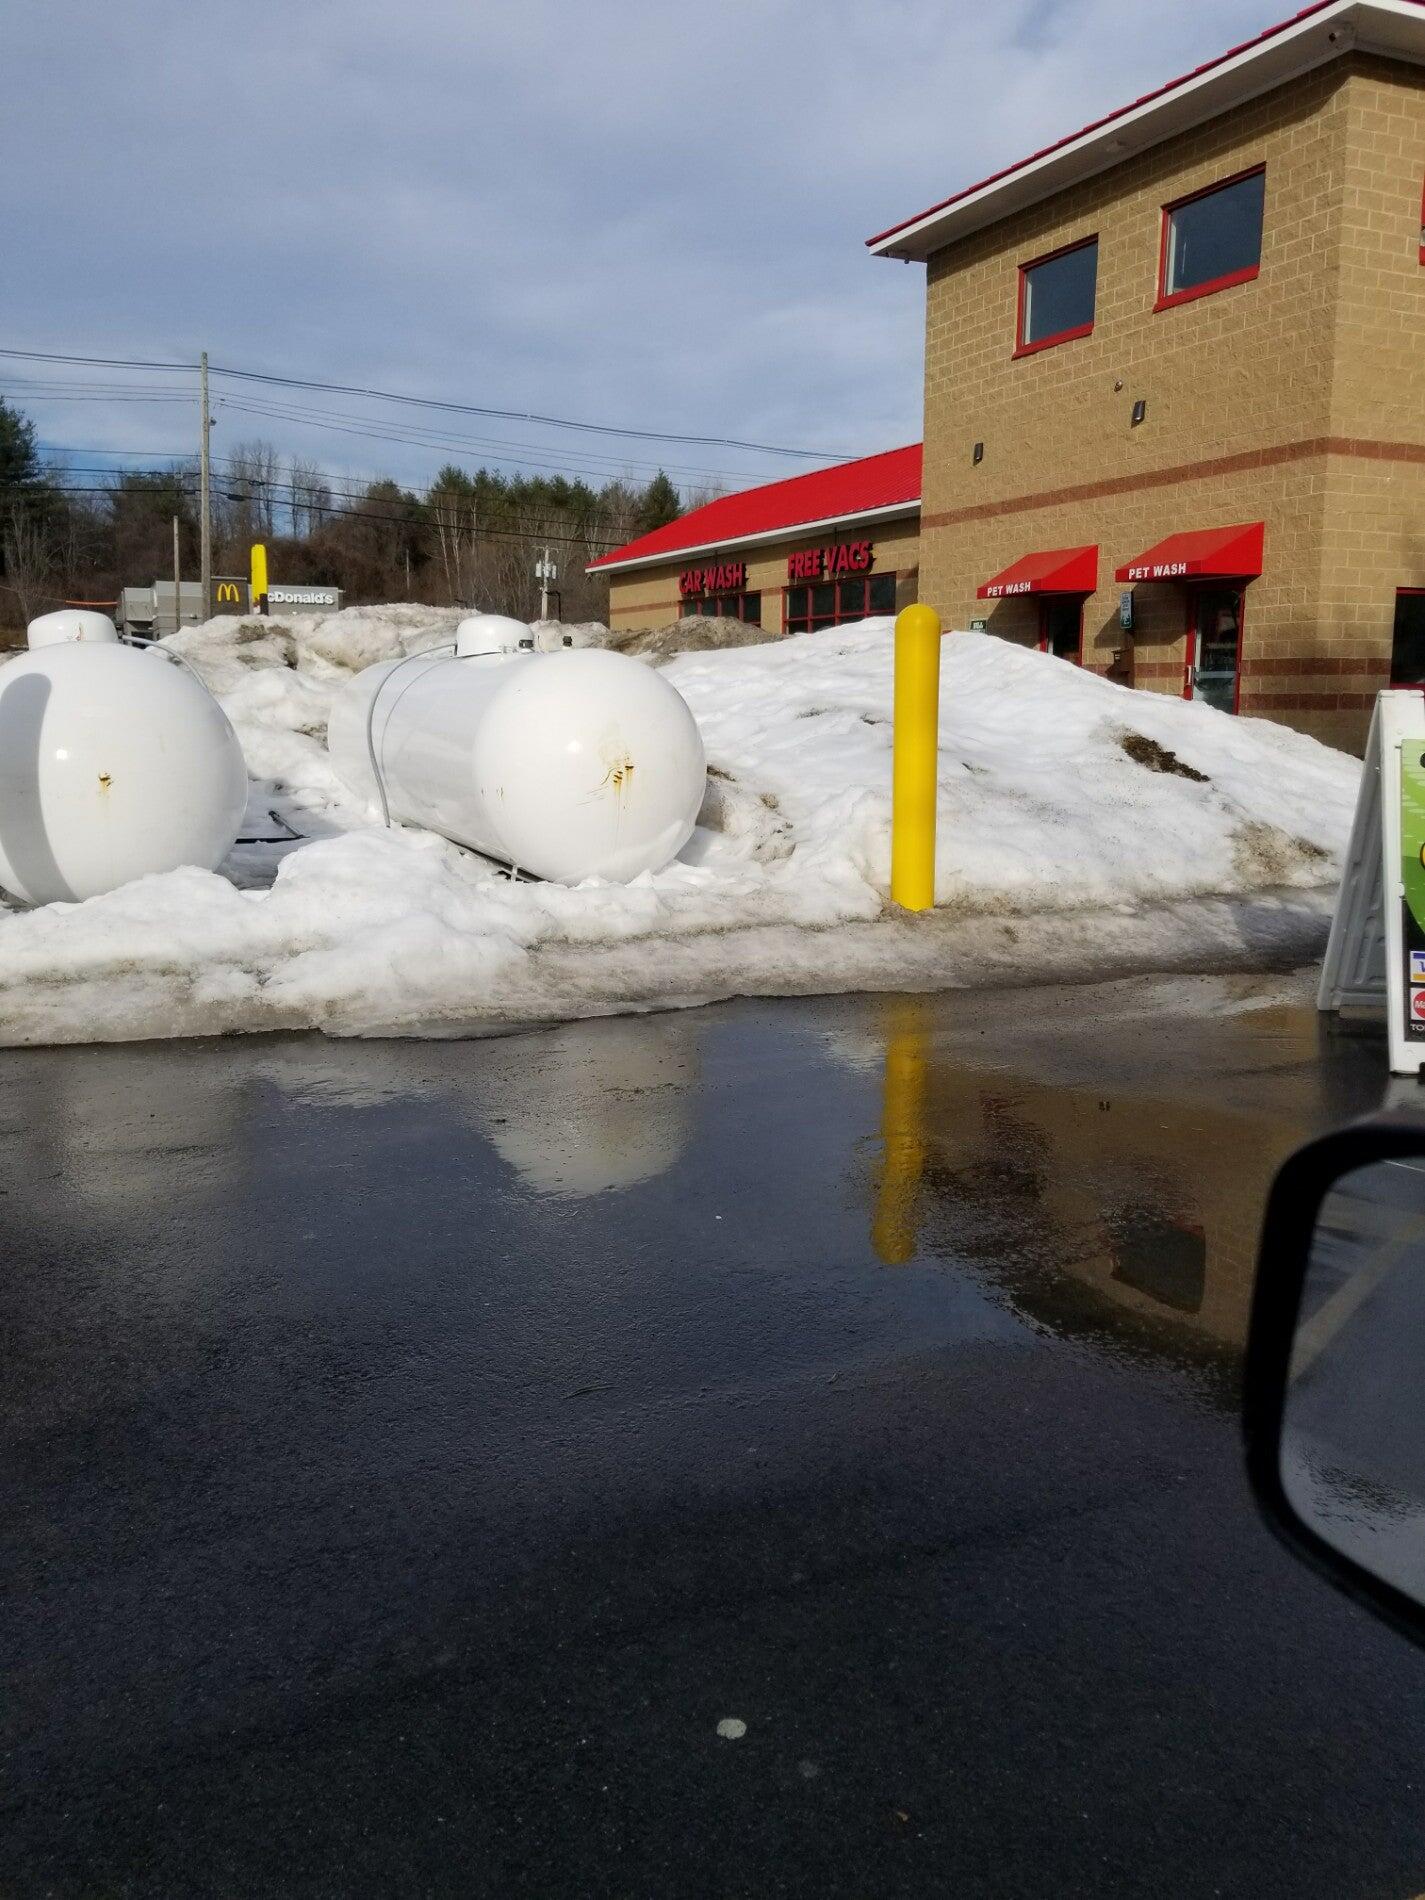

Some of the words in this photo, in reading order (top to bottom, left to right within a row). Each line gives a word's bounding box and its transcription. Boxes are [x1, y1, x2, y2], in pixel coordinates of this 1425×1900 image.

[788, 549, 820, 577] FREE
[825, 541, 871, 572] VACS
[680, 570, 701, 593] CAR
[704, 562, 743, 589] WASH
[1128, 566, 1150, 580] PET
[1153, 563, 1187, 577] WASH
[268, 590, 334, 604] cDonald's
[987, 586, 1004, 597] PET
[1006, 581, 1031, 594] WASH
